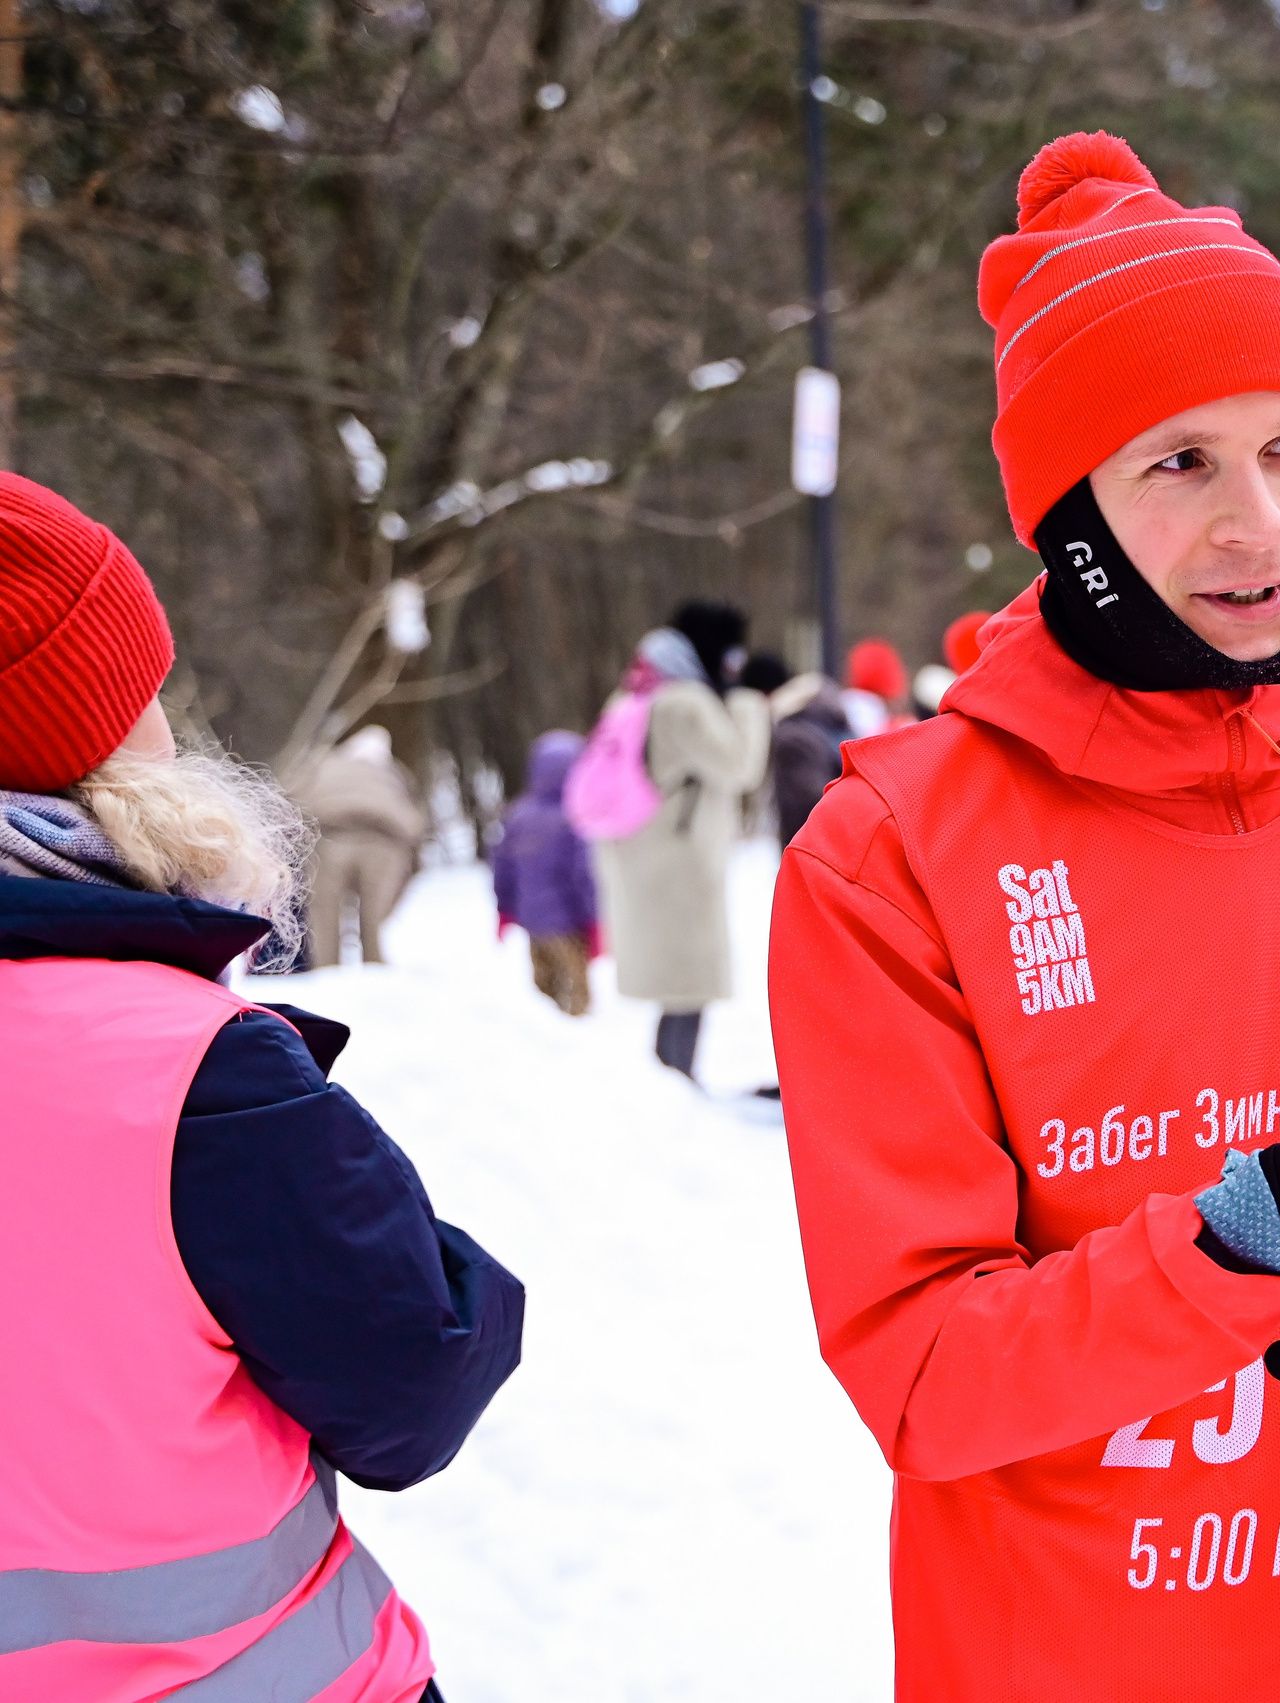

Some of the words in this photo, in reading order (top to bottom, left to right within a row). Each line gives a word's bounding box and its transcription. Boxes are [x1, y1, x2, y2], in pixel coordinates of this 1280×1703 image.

[1065, 541, 1119, 609] GRi
[999, 859, 1078, 923] Sat
[1009, 912, 1088, 970] 9AM
[1016, 957, 1097, 1016] 5KM
[1036, 1104, 1181, 1178] Забег
[1127, 1508, 1258, 1592] 5:00
